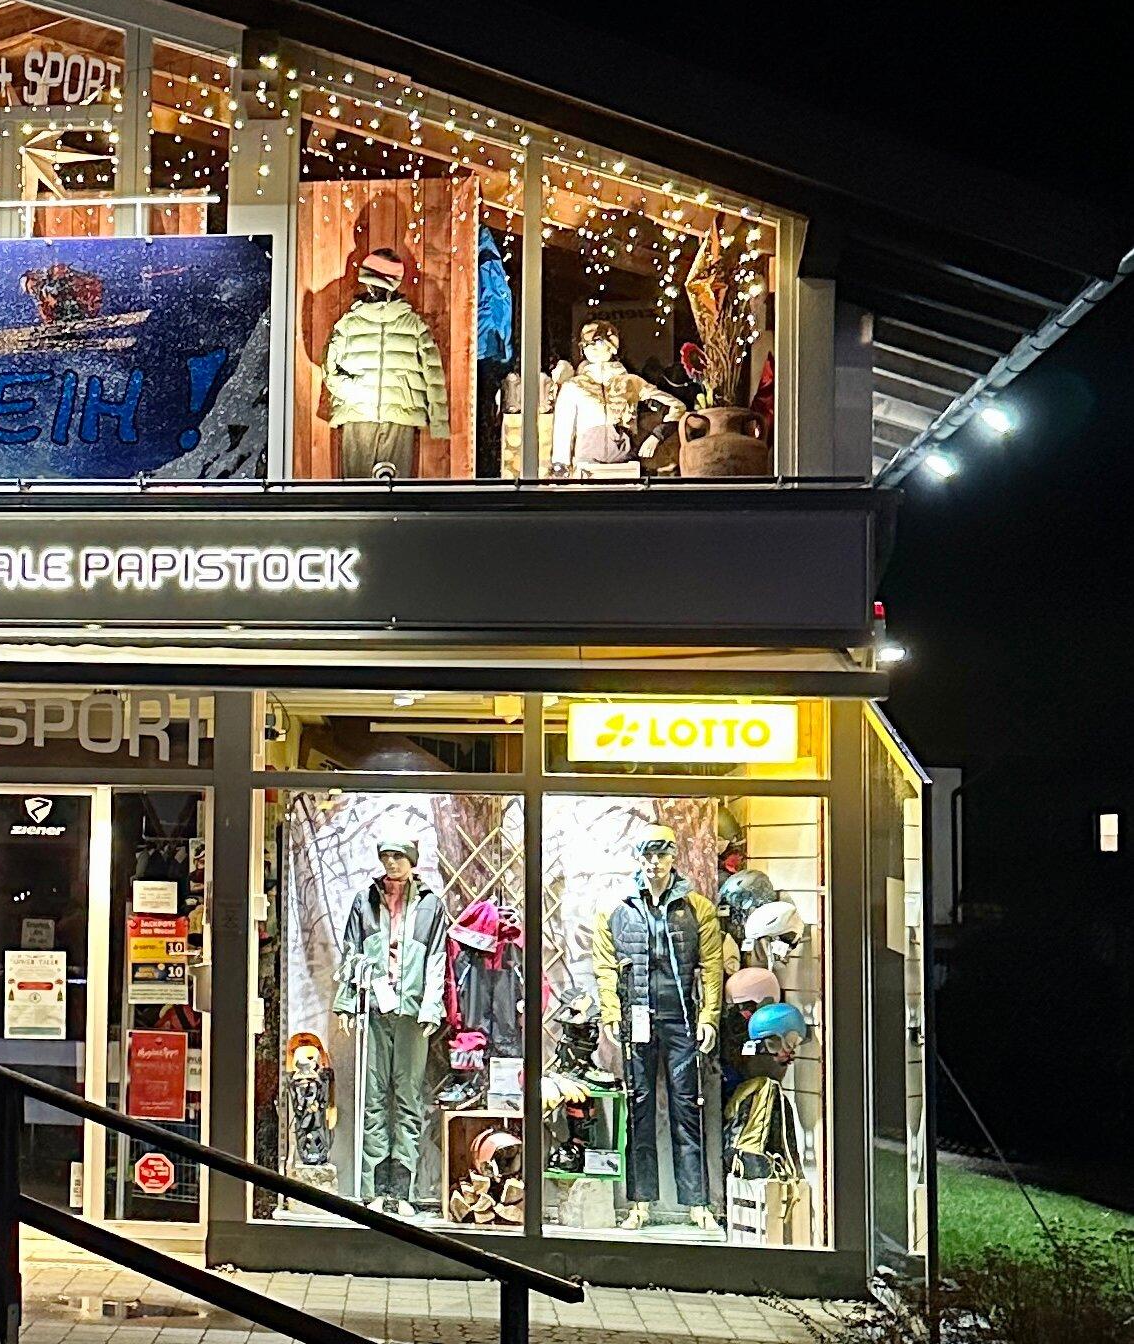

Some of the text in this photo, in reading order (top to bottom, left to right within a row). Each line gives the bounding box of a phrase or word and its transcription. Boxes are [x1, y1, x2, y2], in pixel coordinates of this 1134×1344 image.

[23, 50, 121, 106] SPORT
[79, 545, 361, 589] PAPISTOCK
[648, 717, 771, 748] LOTTO
[167, 942, 183, 953] 10
[167, 967, 183, 978] 10
